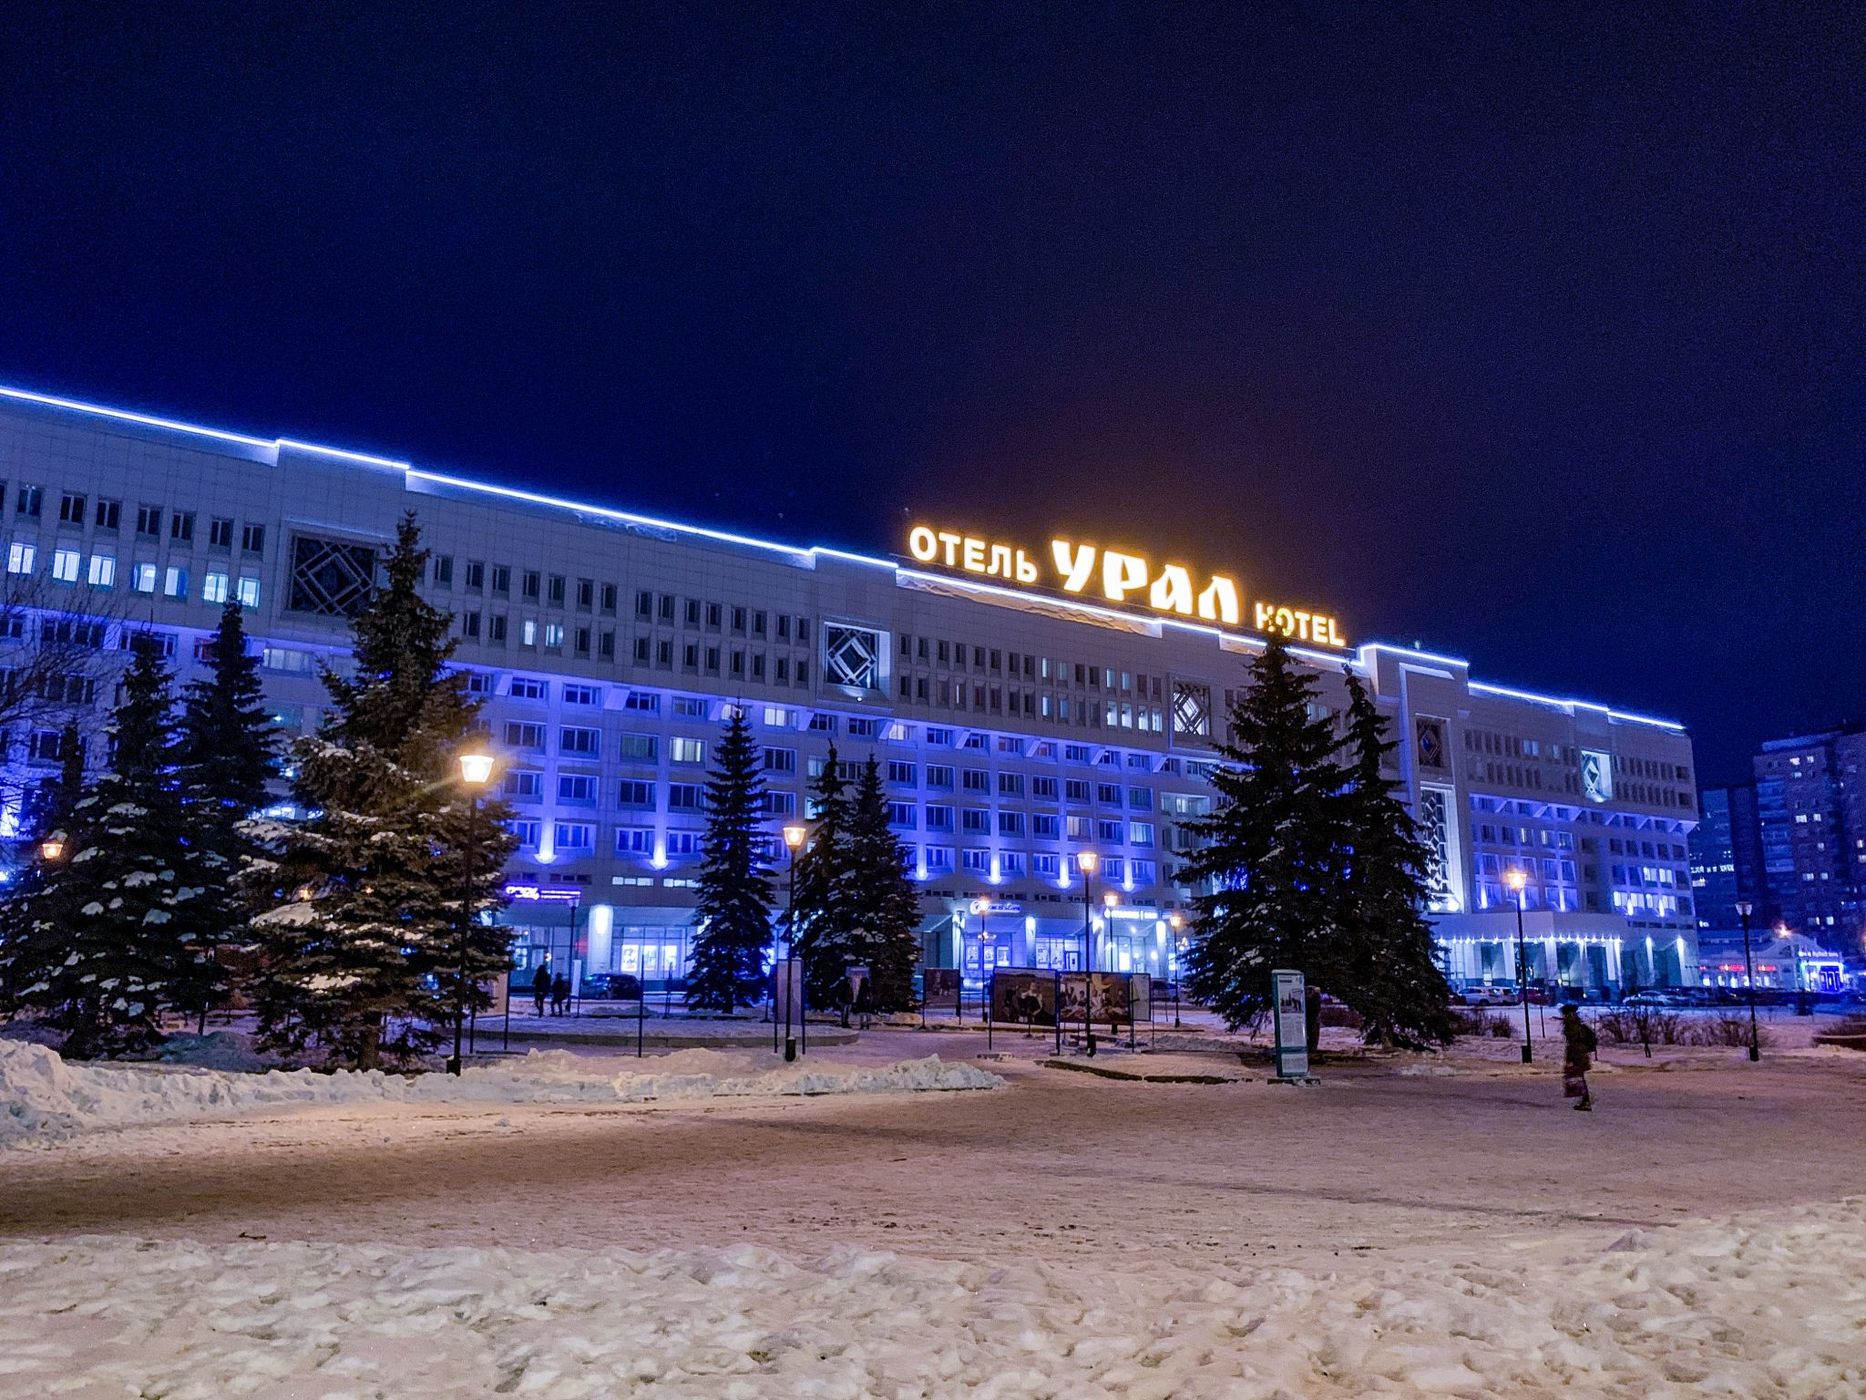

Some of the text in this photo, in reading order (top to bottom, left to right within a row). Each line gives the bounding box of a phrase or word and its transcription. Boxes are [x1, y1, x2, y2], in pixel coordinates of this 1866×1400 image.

[909, 526, 1346, 647] ОТЕЛЬ УРАЛ HOTEL
